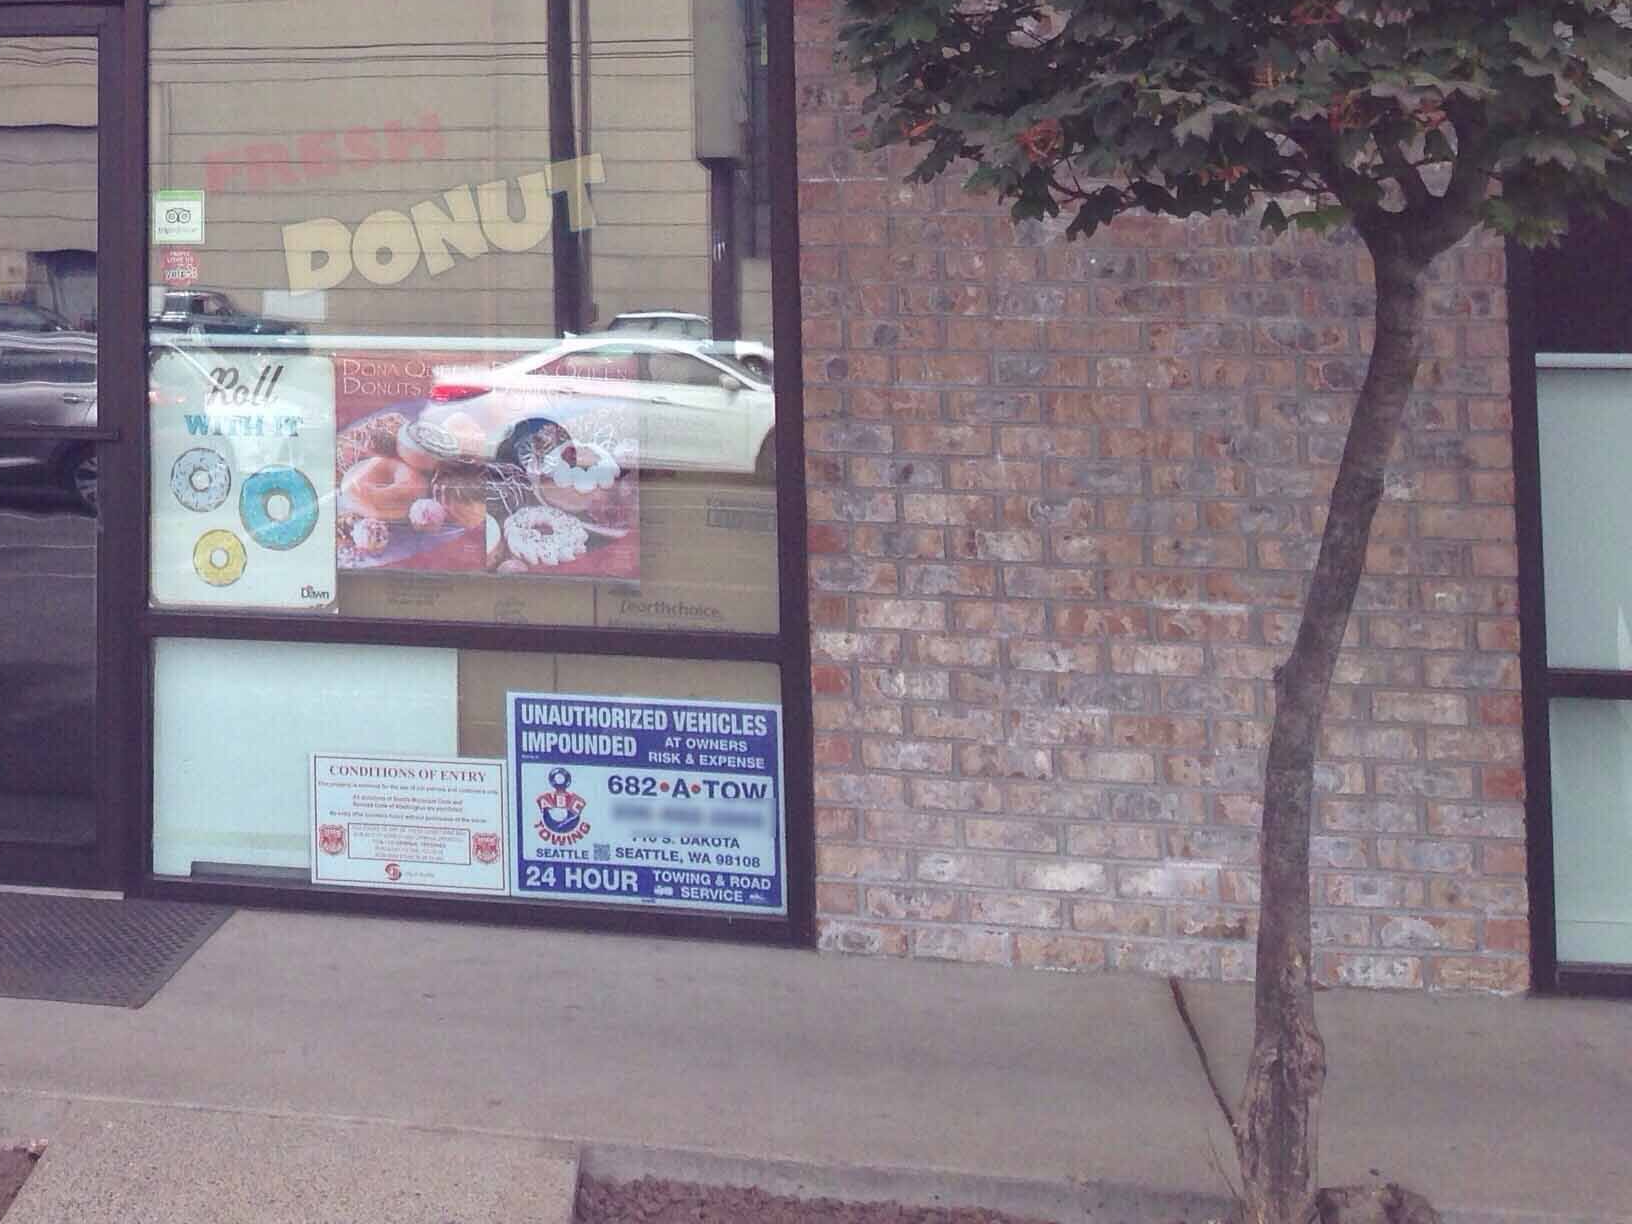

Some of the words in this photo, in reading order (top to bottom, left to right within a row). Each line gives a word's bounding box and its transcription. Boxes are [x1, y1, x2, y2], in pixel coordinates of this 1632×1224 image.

[204, 108, 446, 193] FRESH
[281, 153, 606, 296] DONUT
[343, 359, 400, 377] DONA
[207, 365, 284, 406] Roll
[343, 378, 421, 396] DONUTS
[184, 414, 264, 436] WITH
[273, 415, 303, 437] IT
[301, 585, 330, 600] Dawn
[521, 703, 667, 731] UNAUTHORIZED
[672, 711, 767, 736] VEHICLES
[521, 731, 637, 757] IMPOUNDED
[665, 738, 680, 748] AT
[686, 738, 748, 752] OWNERS
[648, 752, 680, 764] RISK
[685, 753, 694, 765] &
[699, 754, 765, 769] EXPENSE
[329, 765, 415, 778] CONDITIONS
[419, 769, 436, 780] OF
[441, 770, 487, 783] ENTRY
[538, 794, 585, 815] ABC
[534, 821, 591, 846] TOWING
[680, 835, 740, 849] DAKOTA
[536, 848, 589, 859] SEATTLE
[615, 847, 683, 863] SEATTLE,
[688, 851, 711, 864] WA
[715, 854, 760, 868] 98108
[526, 866, 556, 887] 24
[565, 867, 638, 892] HOUR
[652, 870, 711, 886] TOWING
[715, 875, 725, 886] &
[730, 876, 771, 889] ROAD
[681, 887, 743, 902] SERVICE
